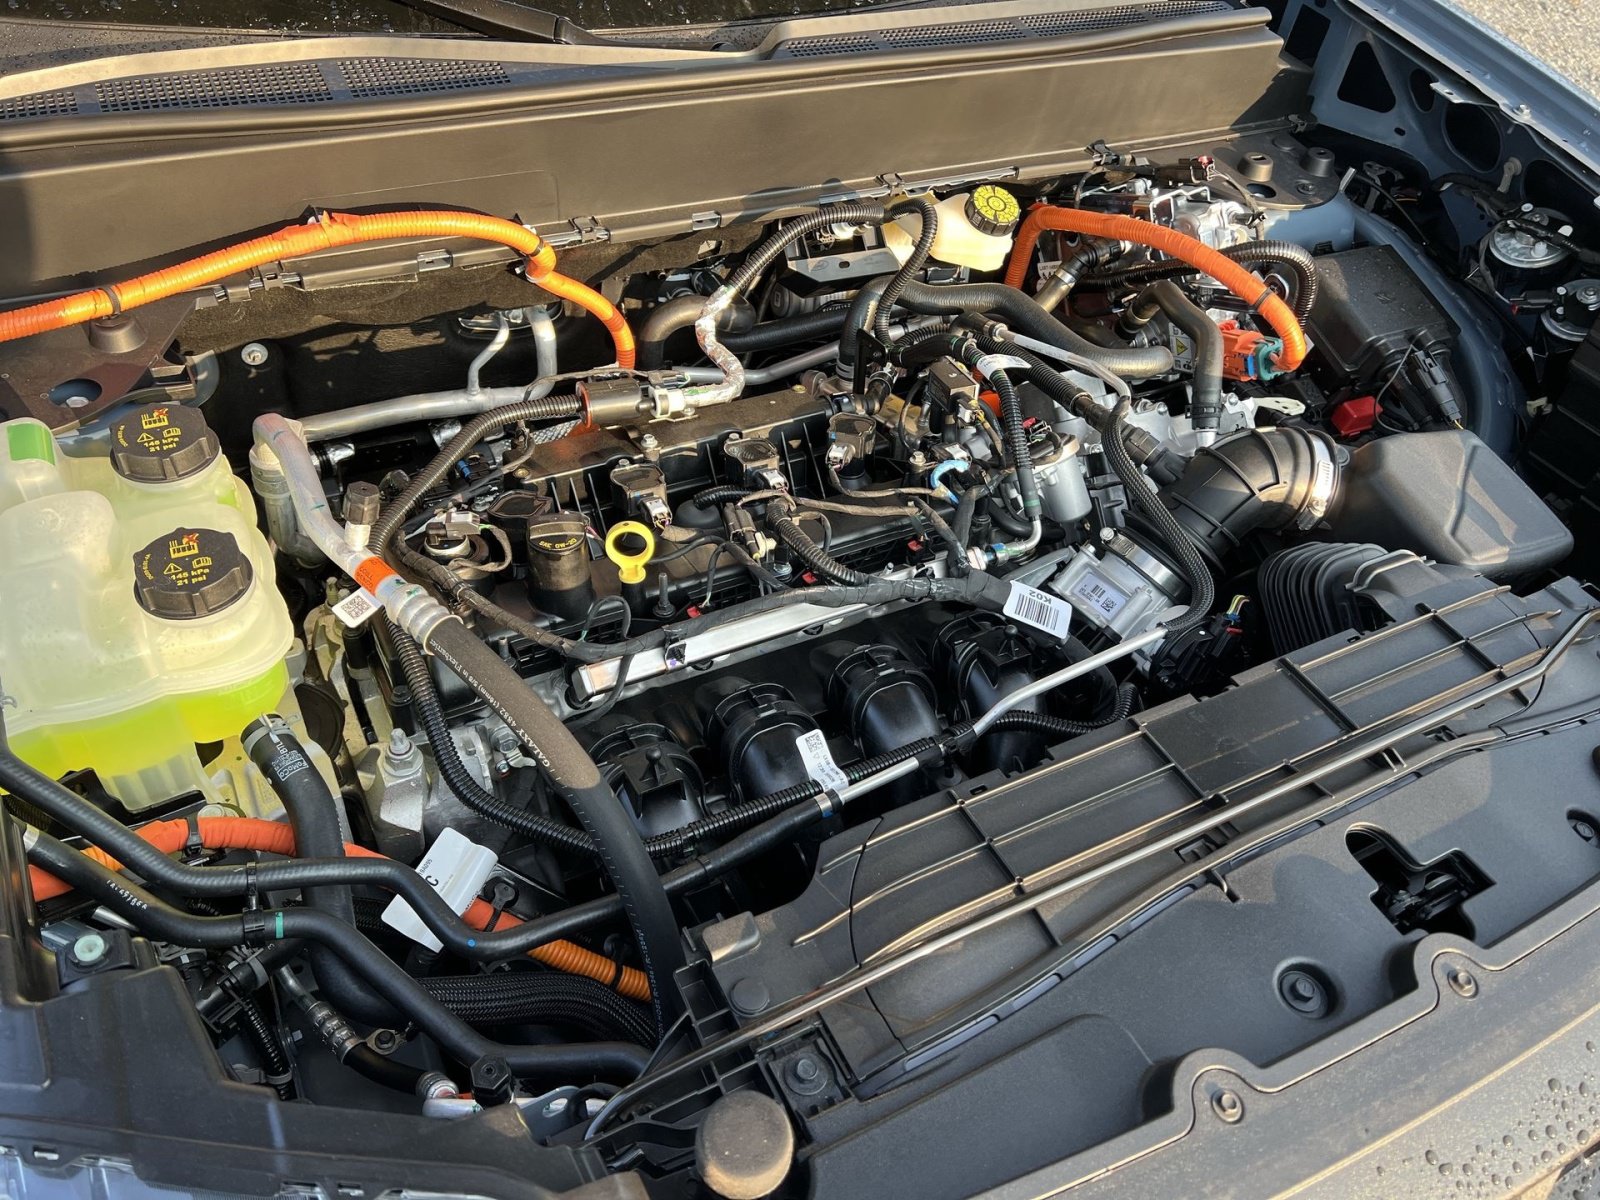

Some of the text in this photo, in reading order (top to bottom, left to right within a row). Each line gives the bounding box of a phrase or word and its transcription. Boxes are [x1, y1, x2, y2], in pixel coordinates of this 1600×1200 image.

[163, 442, 176, 450] psi
[538, 540, 552, 549] SAE
[191, 568, 209, 576] kPa
[191, 574, 206, 584] psi
[1028, 589, 1052, 605] K02
[429, 638, 462, 672] Flexbarrier
[499, 707, 517, 727] 4882
[276, 740, 289, 755] BTL
[516, 728, 551, 767] GALAXY
[279, 760, 308, 778] FoMoCo
